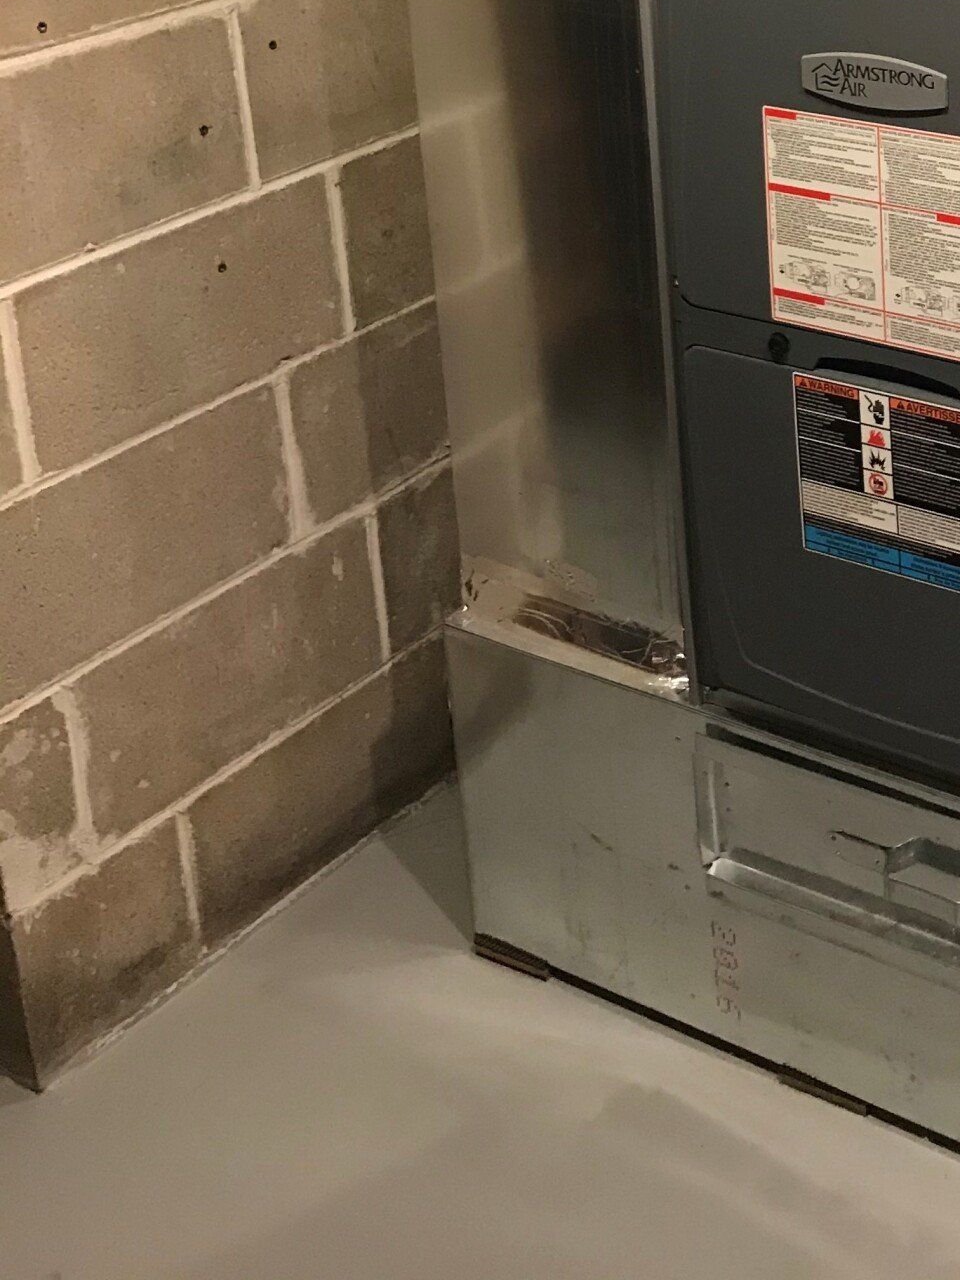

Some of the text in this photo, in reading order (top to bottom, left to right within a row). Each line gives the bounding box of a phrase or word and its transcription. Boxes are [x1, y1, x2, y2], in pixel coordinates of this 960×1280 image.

[833, 59, 935, 90] ARMSTRONG
[839, 78, 868, 98] AIR
[808, 380, 855, 399] WARNING
